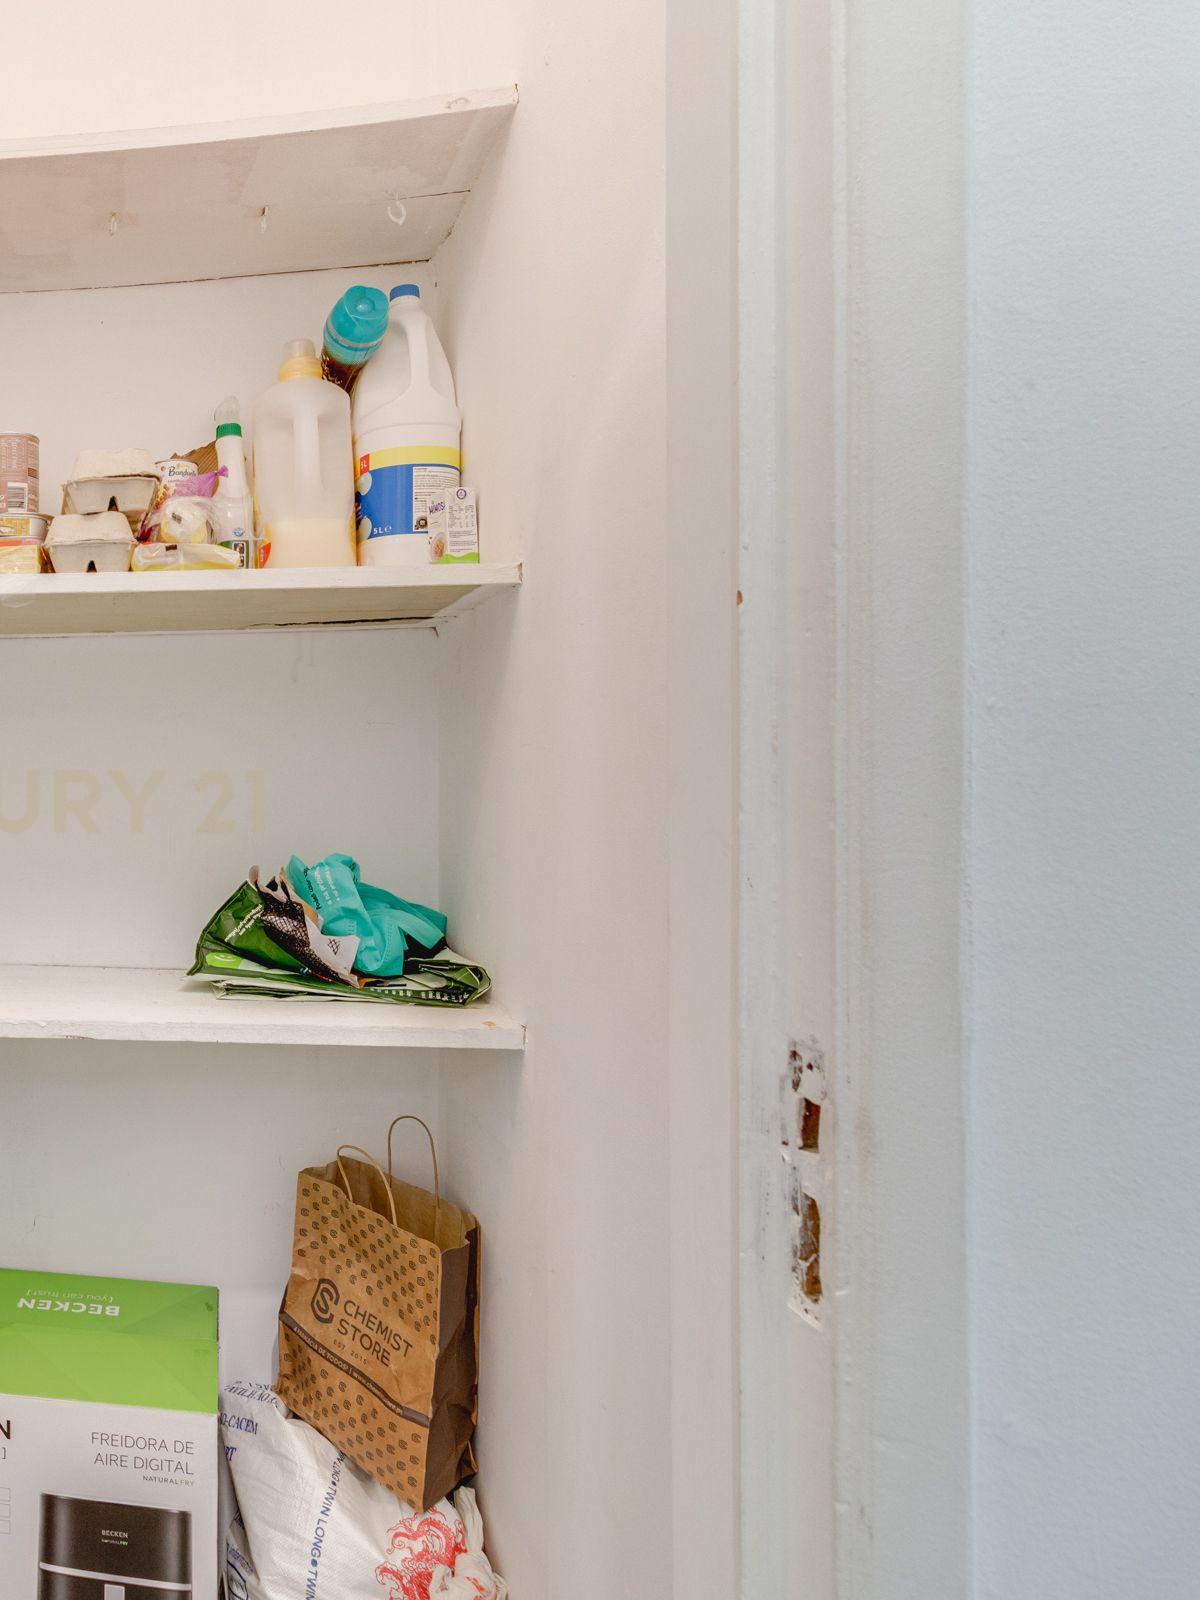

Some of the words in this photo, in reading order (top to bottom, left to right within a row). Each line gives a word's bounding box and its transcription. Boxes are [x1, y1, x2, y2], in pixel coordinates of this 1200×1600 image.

[17, 1298, 120, 1316] BECKEN
[343, 1300, 413, 1358] CHEMIST
[337, 1319, 391, 1368] STORE
[91, 1432, 168, 1452] FREIDORA
[174, 1440, 194, 1455] DE
[94, 1452, 128, 1468] AIRE
[134, 1456, 194, 1476] DIGITAL
[320, 1484, 338, 1516] TWIN
[102, 1530, 128, 1538] BECKEN
[311, 1519, 330, 1558] LONG
